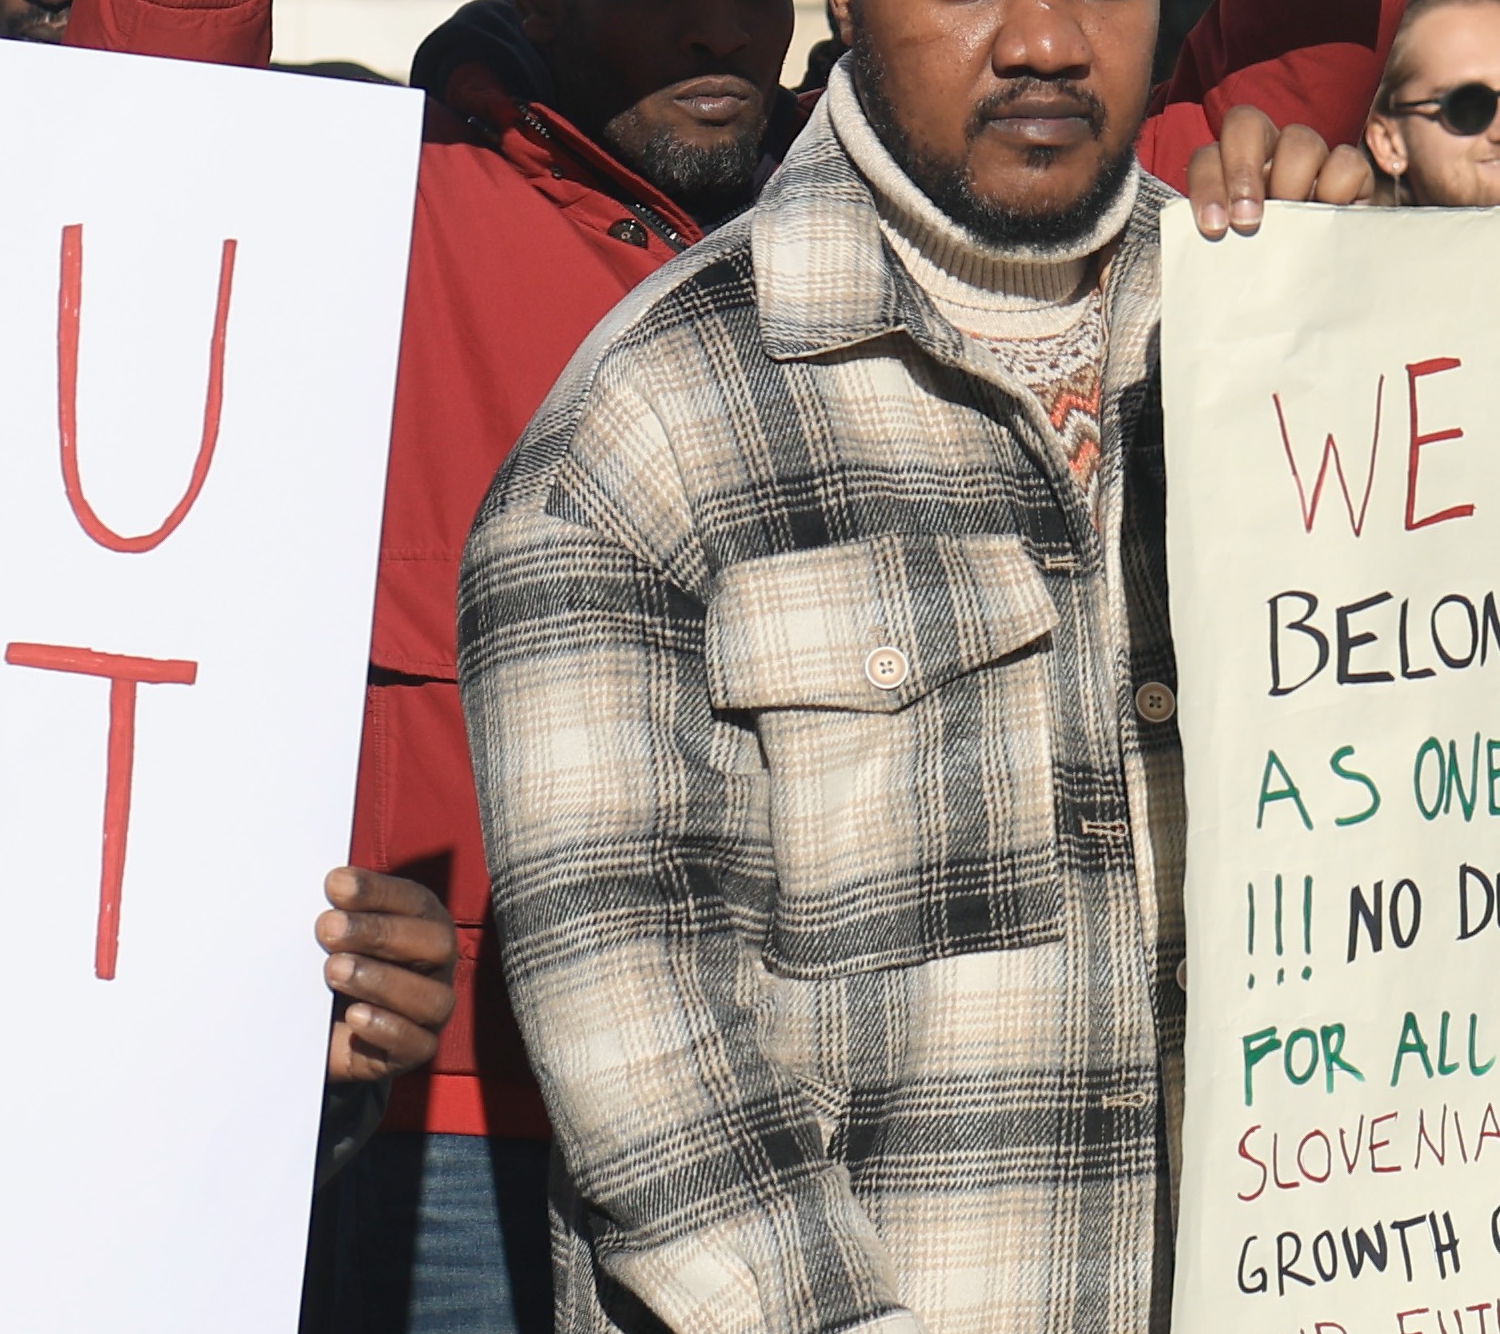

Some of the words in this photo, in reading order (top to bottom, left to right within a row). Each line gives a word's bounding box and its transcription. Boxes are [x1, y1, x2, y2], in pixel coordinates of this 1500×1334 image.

[1272, 357, 1476, 538] WE
[1256, 745, 1381, 831] AS
[1347, 878, 1421, 964] NO
[1242, 1023, 1365, 1107] FOR
[1238, 1210, 1460, 1297] GROWTH
